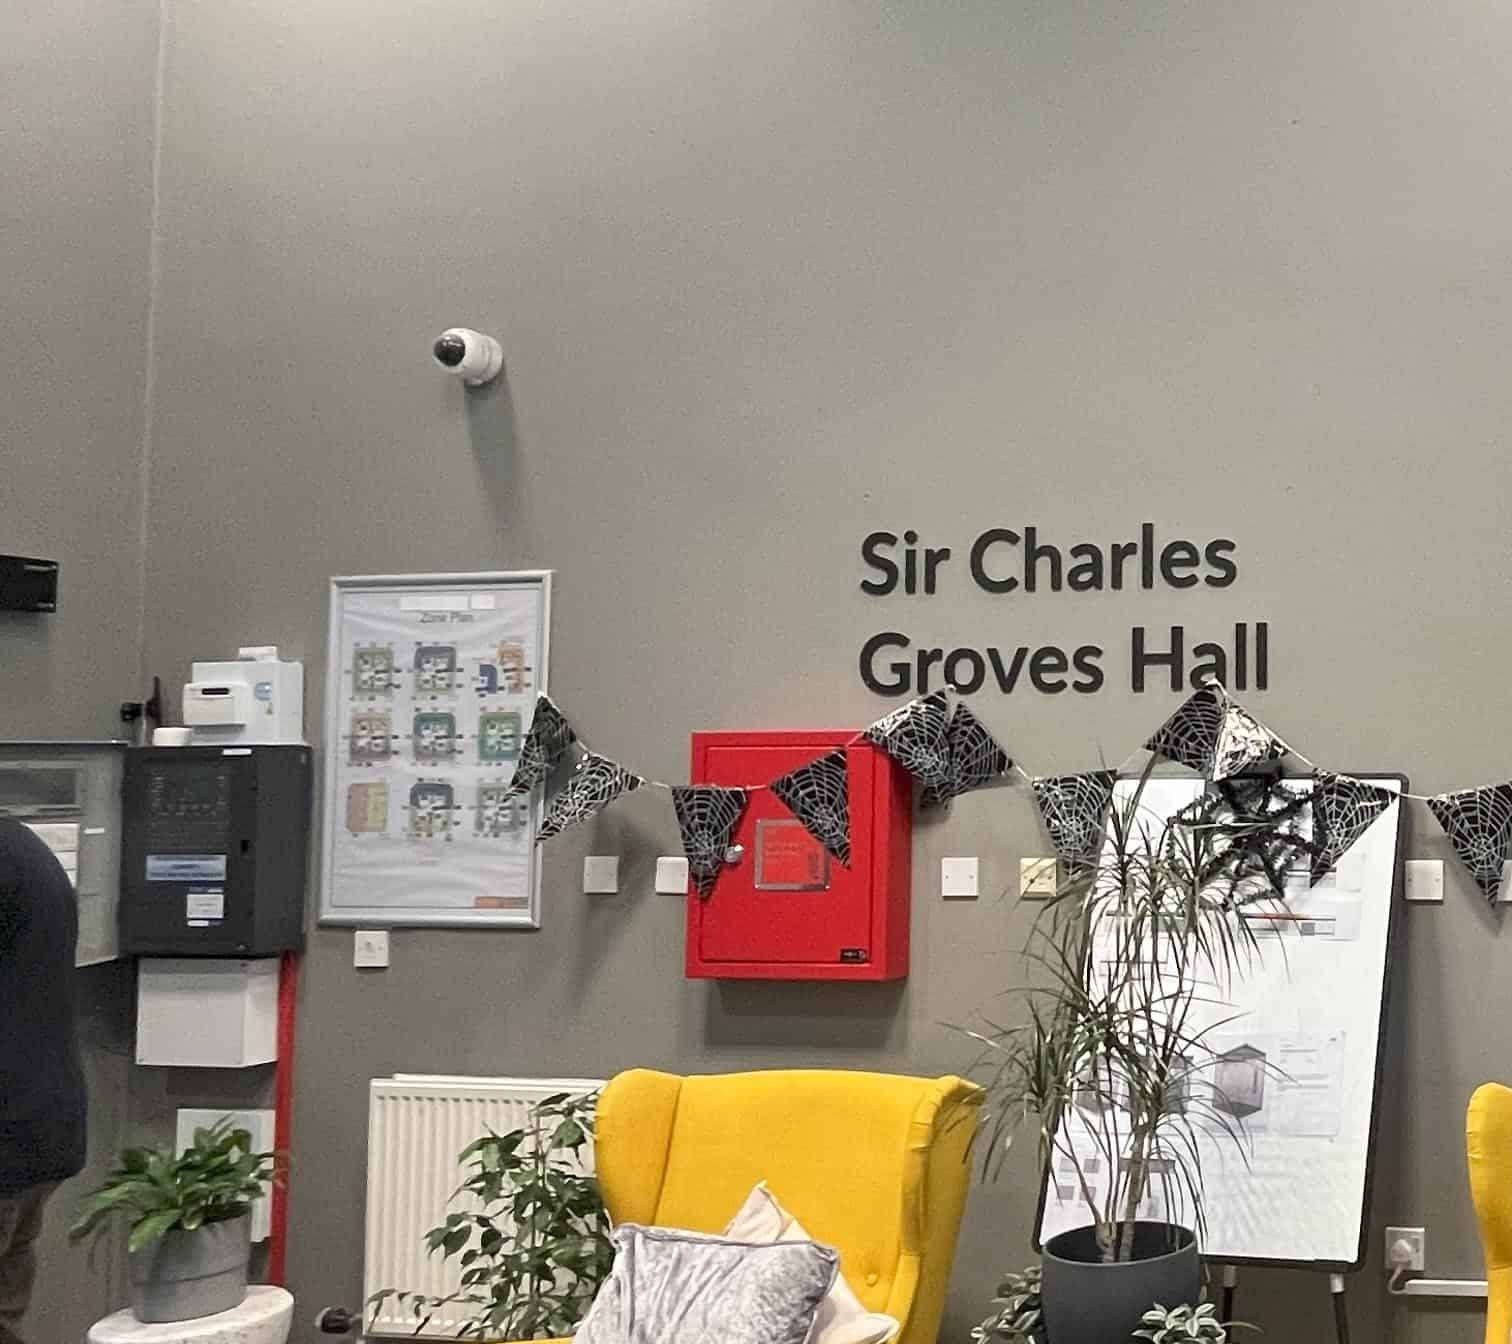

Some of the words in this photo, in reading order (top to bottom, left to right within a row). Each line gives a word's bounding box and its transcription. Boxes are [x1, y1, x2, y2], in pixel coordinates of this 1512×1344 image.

[860, 530, 951, 596] Sir
[970, 522, 1238, 594] Charles
[859, 632, 1105, 697] Groves
[1131, 622, 1269, 694] Hall
